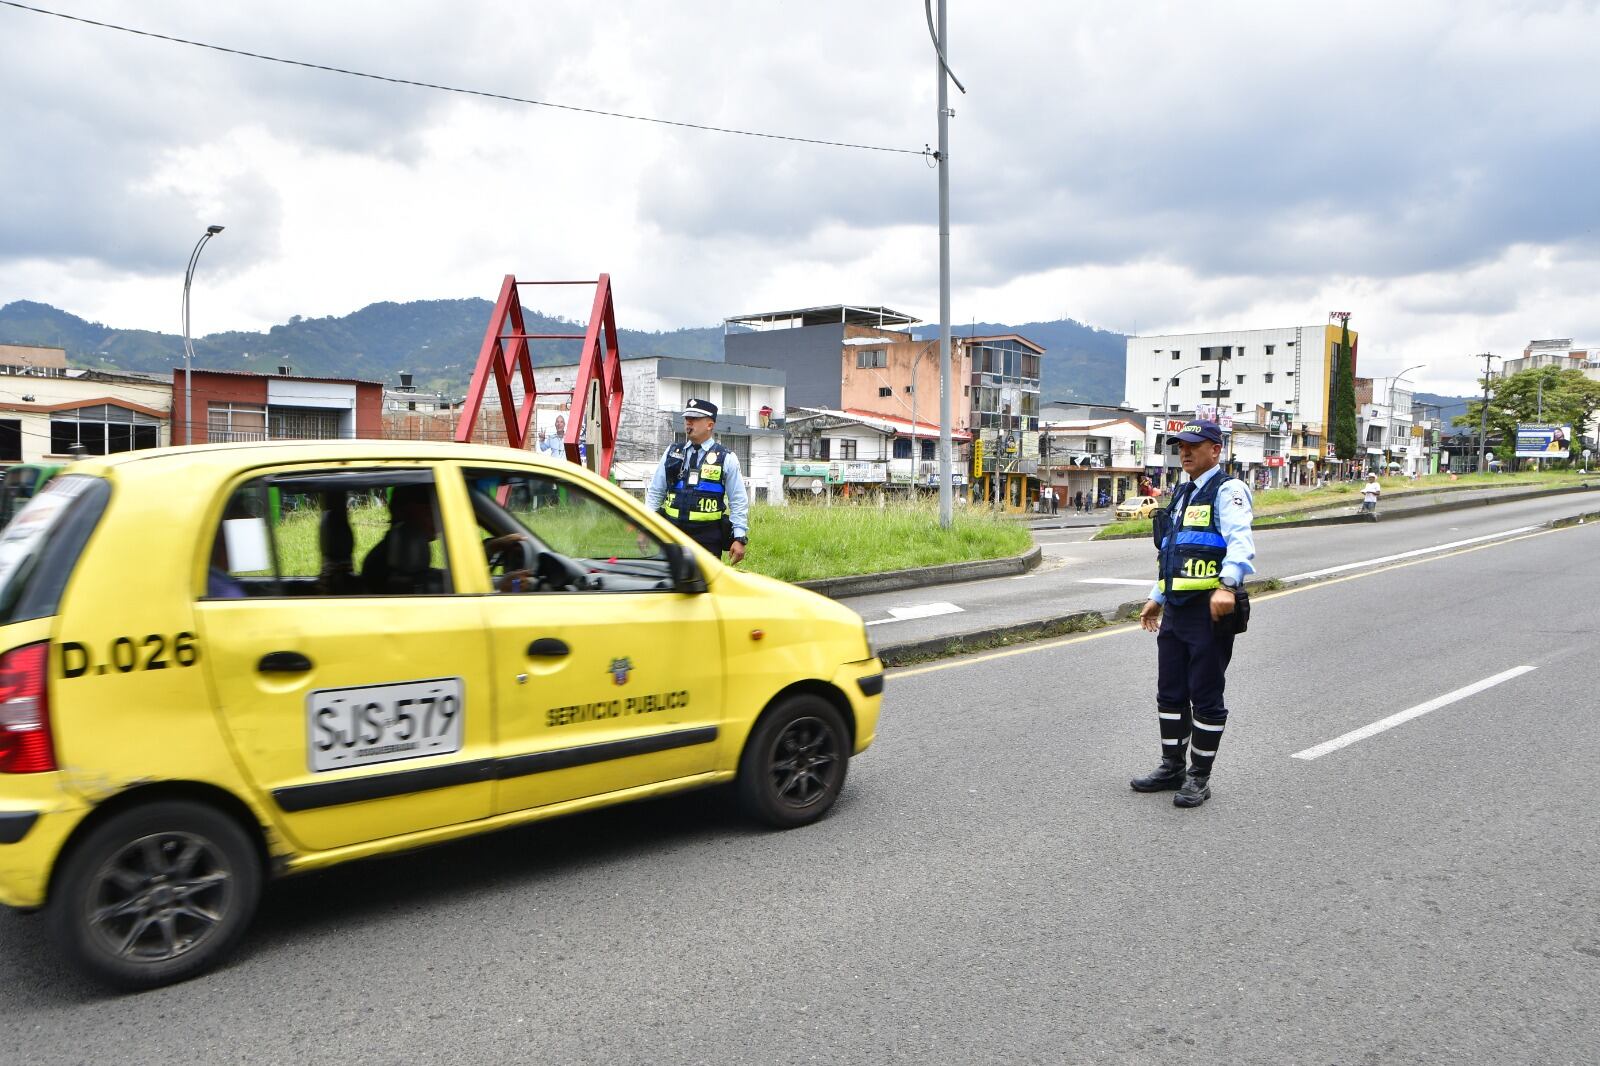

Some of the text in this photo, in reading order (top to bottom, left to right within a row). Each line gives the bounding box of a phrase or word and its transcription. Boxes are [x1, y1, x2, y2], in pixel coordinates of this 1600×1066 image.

[698, 498, 718, 512] 109
[1184, 558, 1217, 577] 106
[60, 631, 199, 679] D.026
[546, 700, 621, 727] SERVICIO
